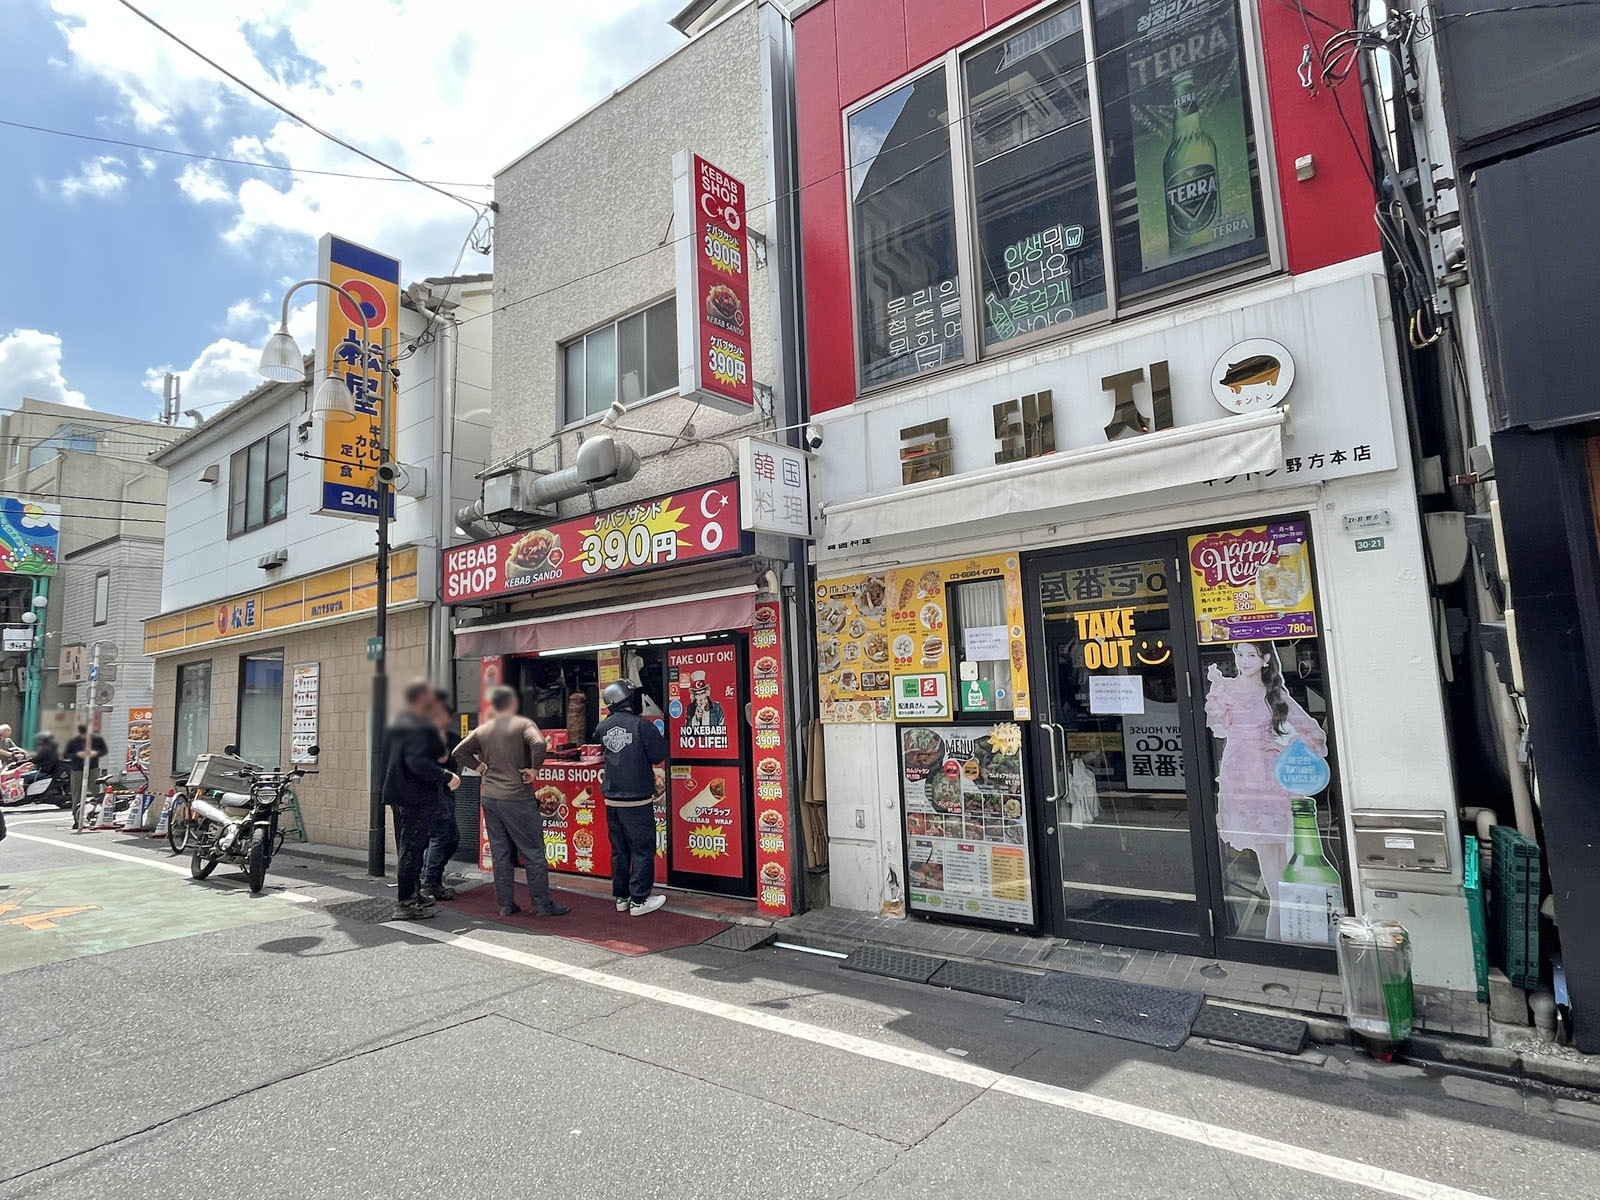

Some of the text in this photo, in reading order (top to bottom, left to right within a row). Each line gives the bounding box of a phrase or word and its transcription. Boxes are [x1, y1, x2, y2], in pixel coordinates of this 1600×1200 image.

[1130, 25, 1229, 85] TERRA
[1174, 92, 1196, 108] TERRA
[700, 162, 738, 194] KEBAB
[701, 175, 738, 206] SHOP
[1168, 176, 1218, 206] TERRA
[705, 222, 739, 246] ケバブサンド
[1212, 218, 1249, 239] TERRA
[704, 234, 742, 274] 390円
[1004, 226, 1064, 270] 인생뭐
[1008, 253, 1069, 297] 있나요
[1010, 279, 1070, 320] 즐겁게
[706, 314, 745, 337] KEBAB SANDO
[710, 335, 744, 357] ケバブサンド
[339, 328, 382, 416] 松屋
[708, 348, 747, 385] 390円
[1235, 393, 1273, 407] キントン
[899, 359, 1174, 486] 금돼지
[355, 435, 367, 471] カレー
[369, 425, 381, 461] 牛めし
[340, 444, 353, 478] 定食
[753, 450, 800, 488] 韓国
[341, 491, 378, 510] 24h
[754, 489, 804, 526] 料理
[594, 502, 661, 531] ケバブサンド
[581, 524, 677, 574] 390円
[1357, 540, 1381, 549] 30-21
[448, 544, 497, 573] KEBAB
[448, 566, 497, 597] SHOP
[504, 568, 563, 588] KEBAB SANDO
[1233, 591, 1255, 601] 390円
[1235, 601, 1256, 611] 320円
[232, 599, 255, 629] 松屋
[1074, 609, 1136, 640] TAKE
[1287, 623, 1313, 634] 780円
[752, 634, 777, 646] 390円
[670, 650, 733, 666] TAKE OUT OK!
[1084, 639, 1133, 670] OUT
[754, 685, 779, 696] 390円
[680, 725, 727, 735] NO KEBAB!!
[756, 735, 781, 746] 390円
[680, 736, 728, 749] NO LIFE!!
[945, 739, 973, 755] MENU
[568, 769, 597, 782] SHOP
[757, 787, 783, 798] 390円
[653, 805, 667, 814] SAN
[695, 807, 731, 816] ケバブラップ
[543, 830, 566, 839] ブサンド
[548, 820, 568, 828] SANDO
[546, 842, 568, 863] 0円
[688, 833, 726, 853] 600円
[760, 839, 785, 852] 390円
[761, 891, 786, 906] 390円
